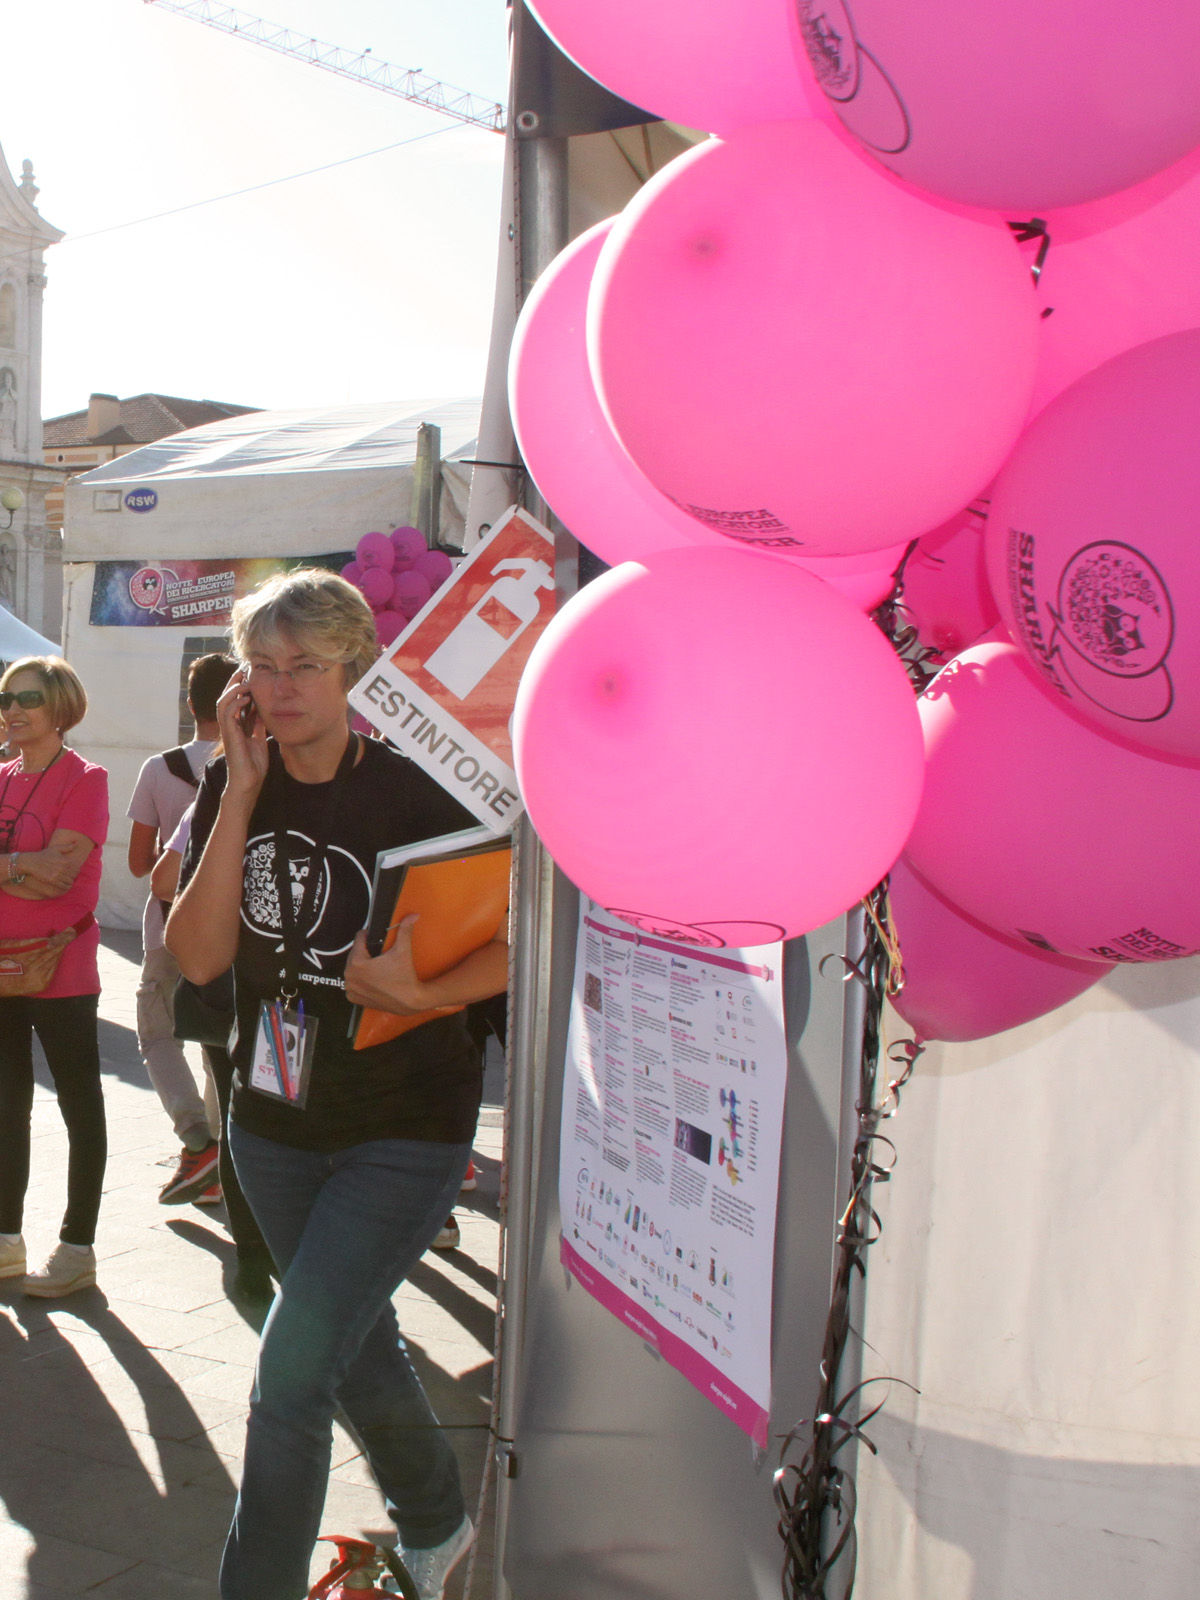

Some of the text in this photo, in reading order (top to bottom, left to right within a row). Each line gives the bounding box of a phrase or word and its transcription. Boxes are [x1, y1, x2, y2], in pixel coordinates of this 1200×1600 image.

[127, 494, 155, 507] RSW
[166, 570, 235, 591] NOTTE EUROPEA
[166, 578, 235, 598] DEI RICERCATORI
[171, 595, 233, 619] SHARPER
[362, 674, 519, 818] ESTINTORE
